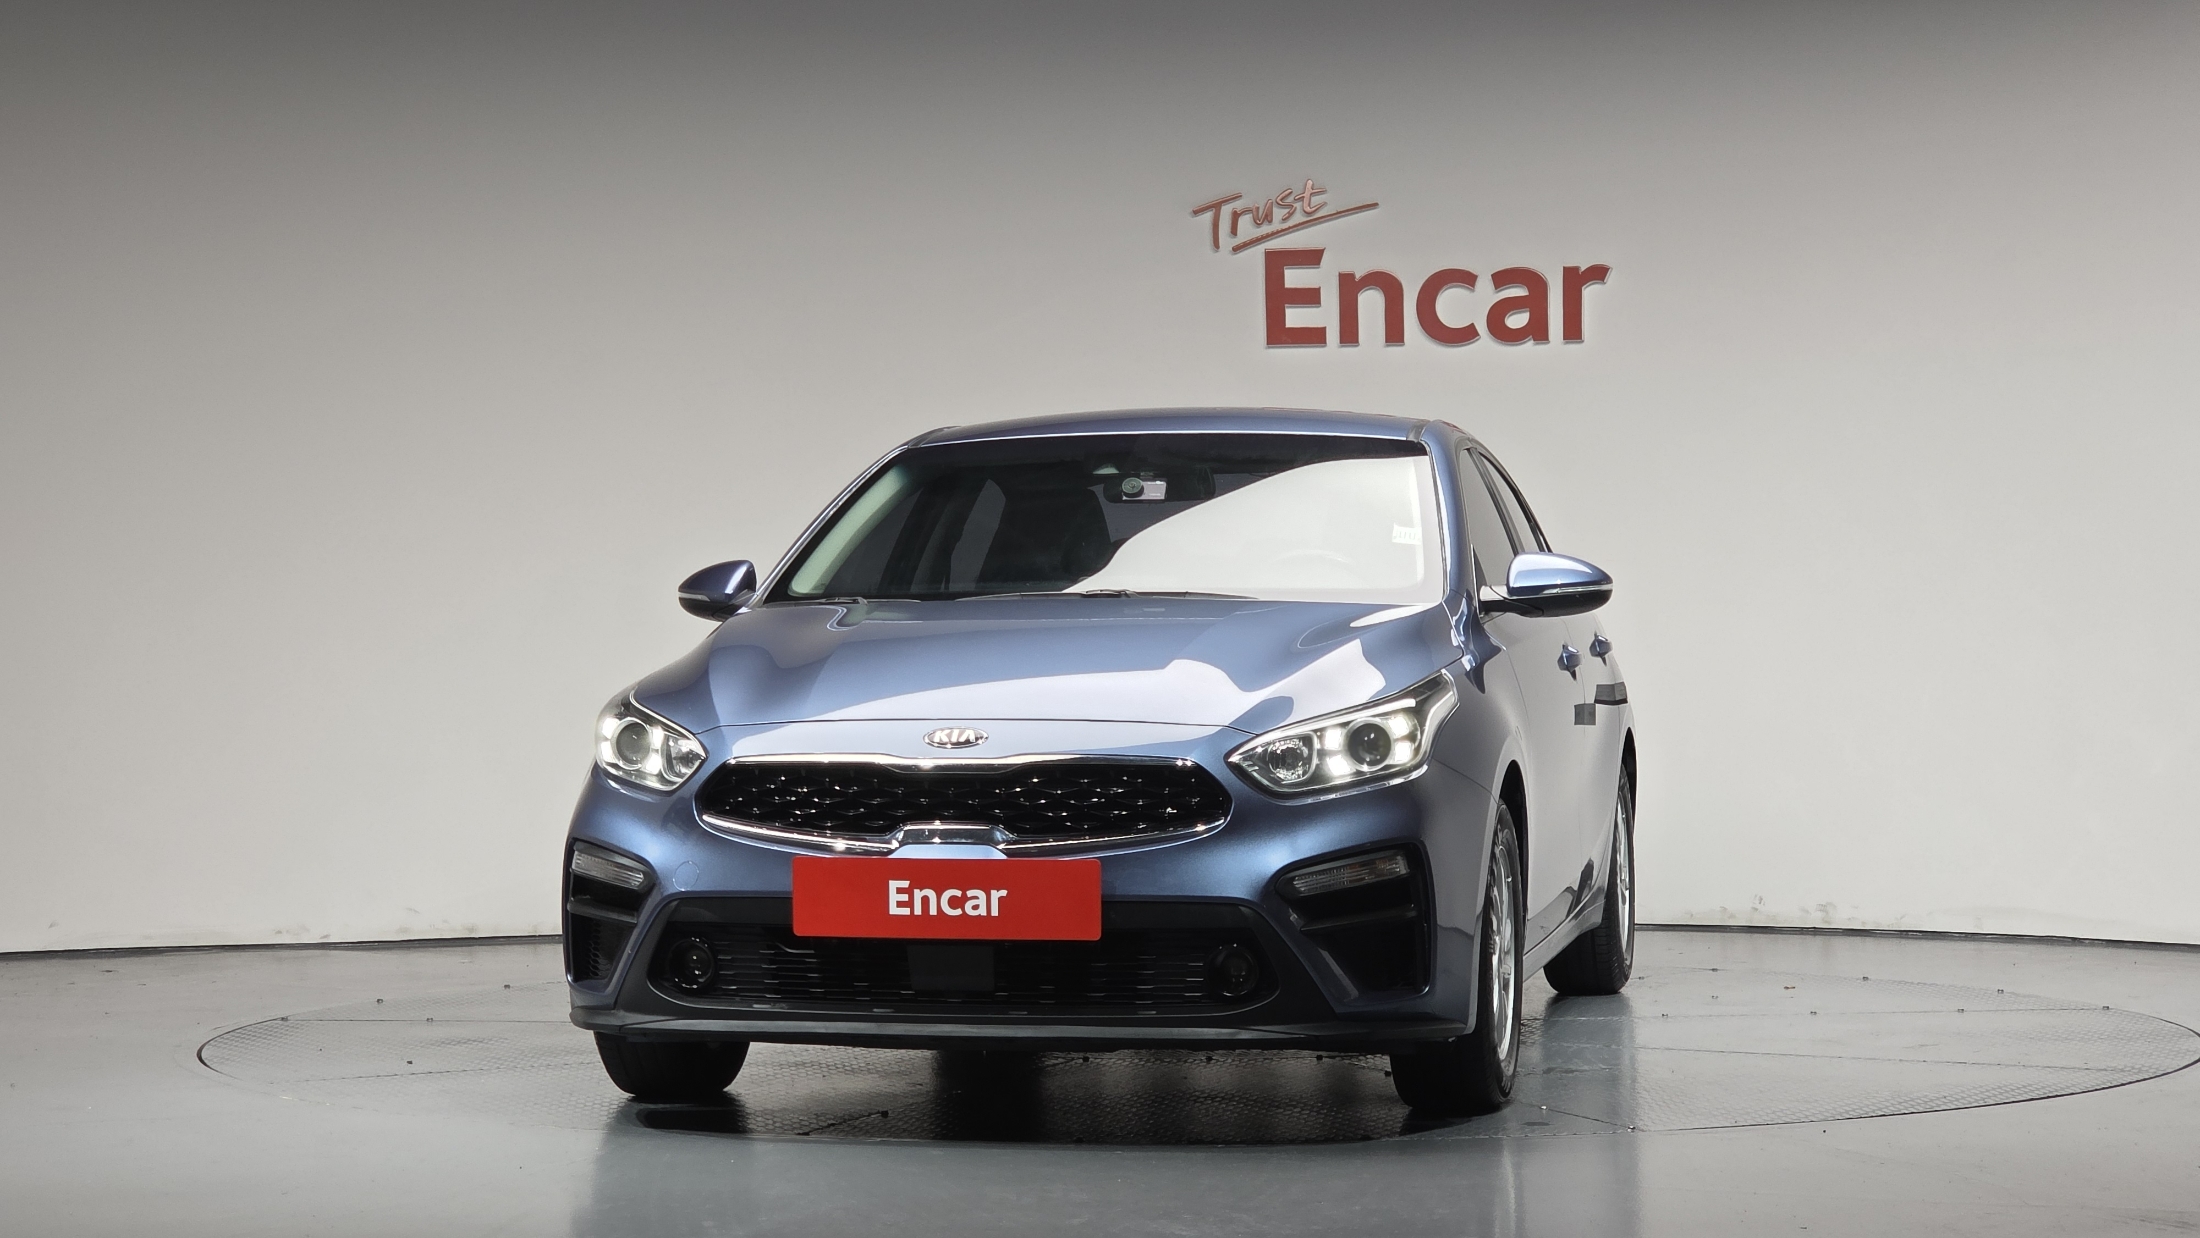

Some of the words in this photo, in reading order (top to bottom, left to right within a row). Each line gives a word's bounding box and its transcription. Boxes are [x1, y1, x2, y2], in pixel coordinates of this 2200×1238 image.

[1192, 179, 1328, 251] Trust
[1264, 247, 1613, 347] Encar
[933, 729, 976, 743] KIA
[888, 880, 1008, 917] Encar
